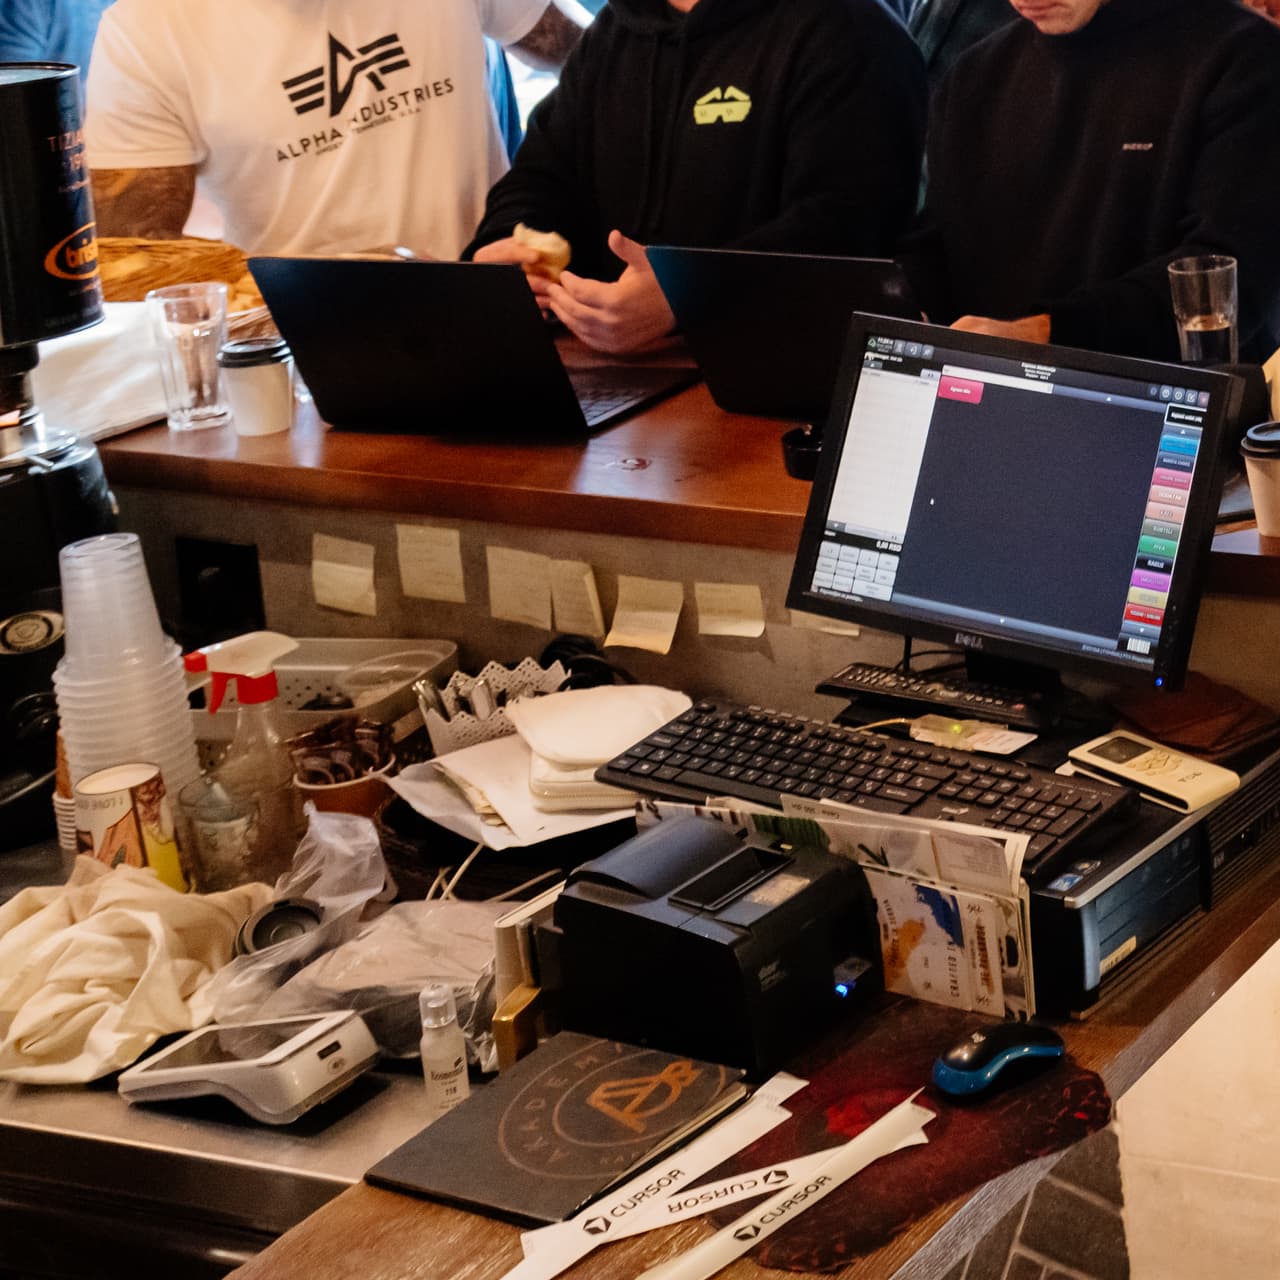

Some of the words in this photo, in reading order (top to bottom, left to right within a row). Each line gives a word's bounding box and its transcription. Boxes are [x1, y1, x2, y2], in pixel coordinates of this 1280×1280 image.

[276, 127, 344, 163] ALPHA
[351, 77, 455, 123] DUSTRIES
[609, 1168, 687, 1218] CURSOR
[666, 1179, 759, 1214] CURSOR
[759, 1175, 832, 1225] CURSOR
